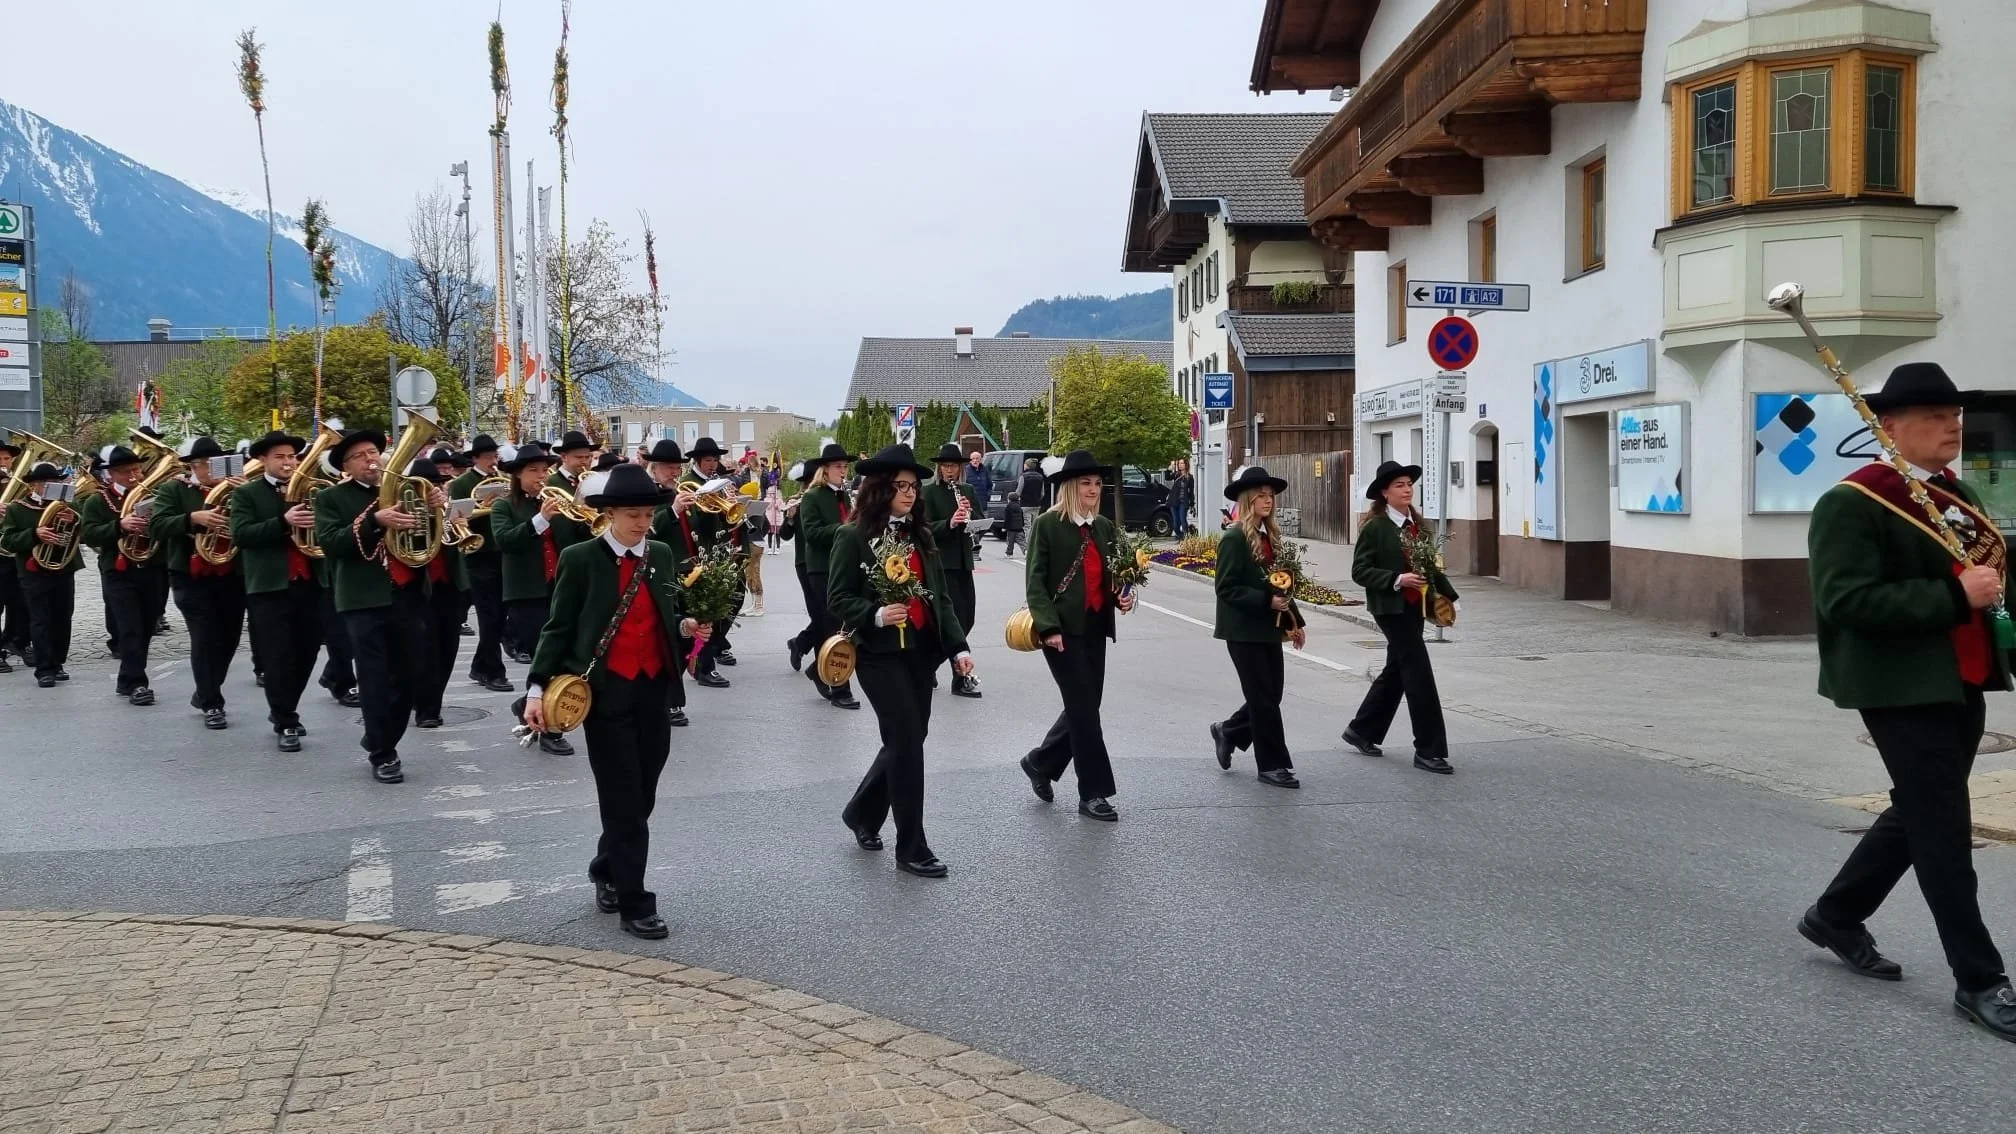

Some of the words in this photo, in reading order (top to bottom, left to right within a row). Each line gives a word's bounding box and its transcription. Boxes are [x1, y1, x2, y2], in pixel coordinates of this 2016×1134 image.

[1436, 289, 1455, 302] 171
[1482, 291, 1498, 302] A12
[1594, 361, 1617, 385] Drei.
[1361, 400, 1375, 414] EURO
[1375, 397, 1387, 411] TAXI
[1435, 398, 1465, 411] Anfang
[1643, 419, 1659, 432] aus
[1621, 436, 1641, 451] einer
[1643, 432, 1669, 450] Hand.
